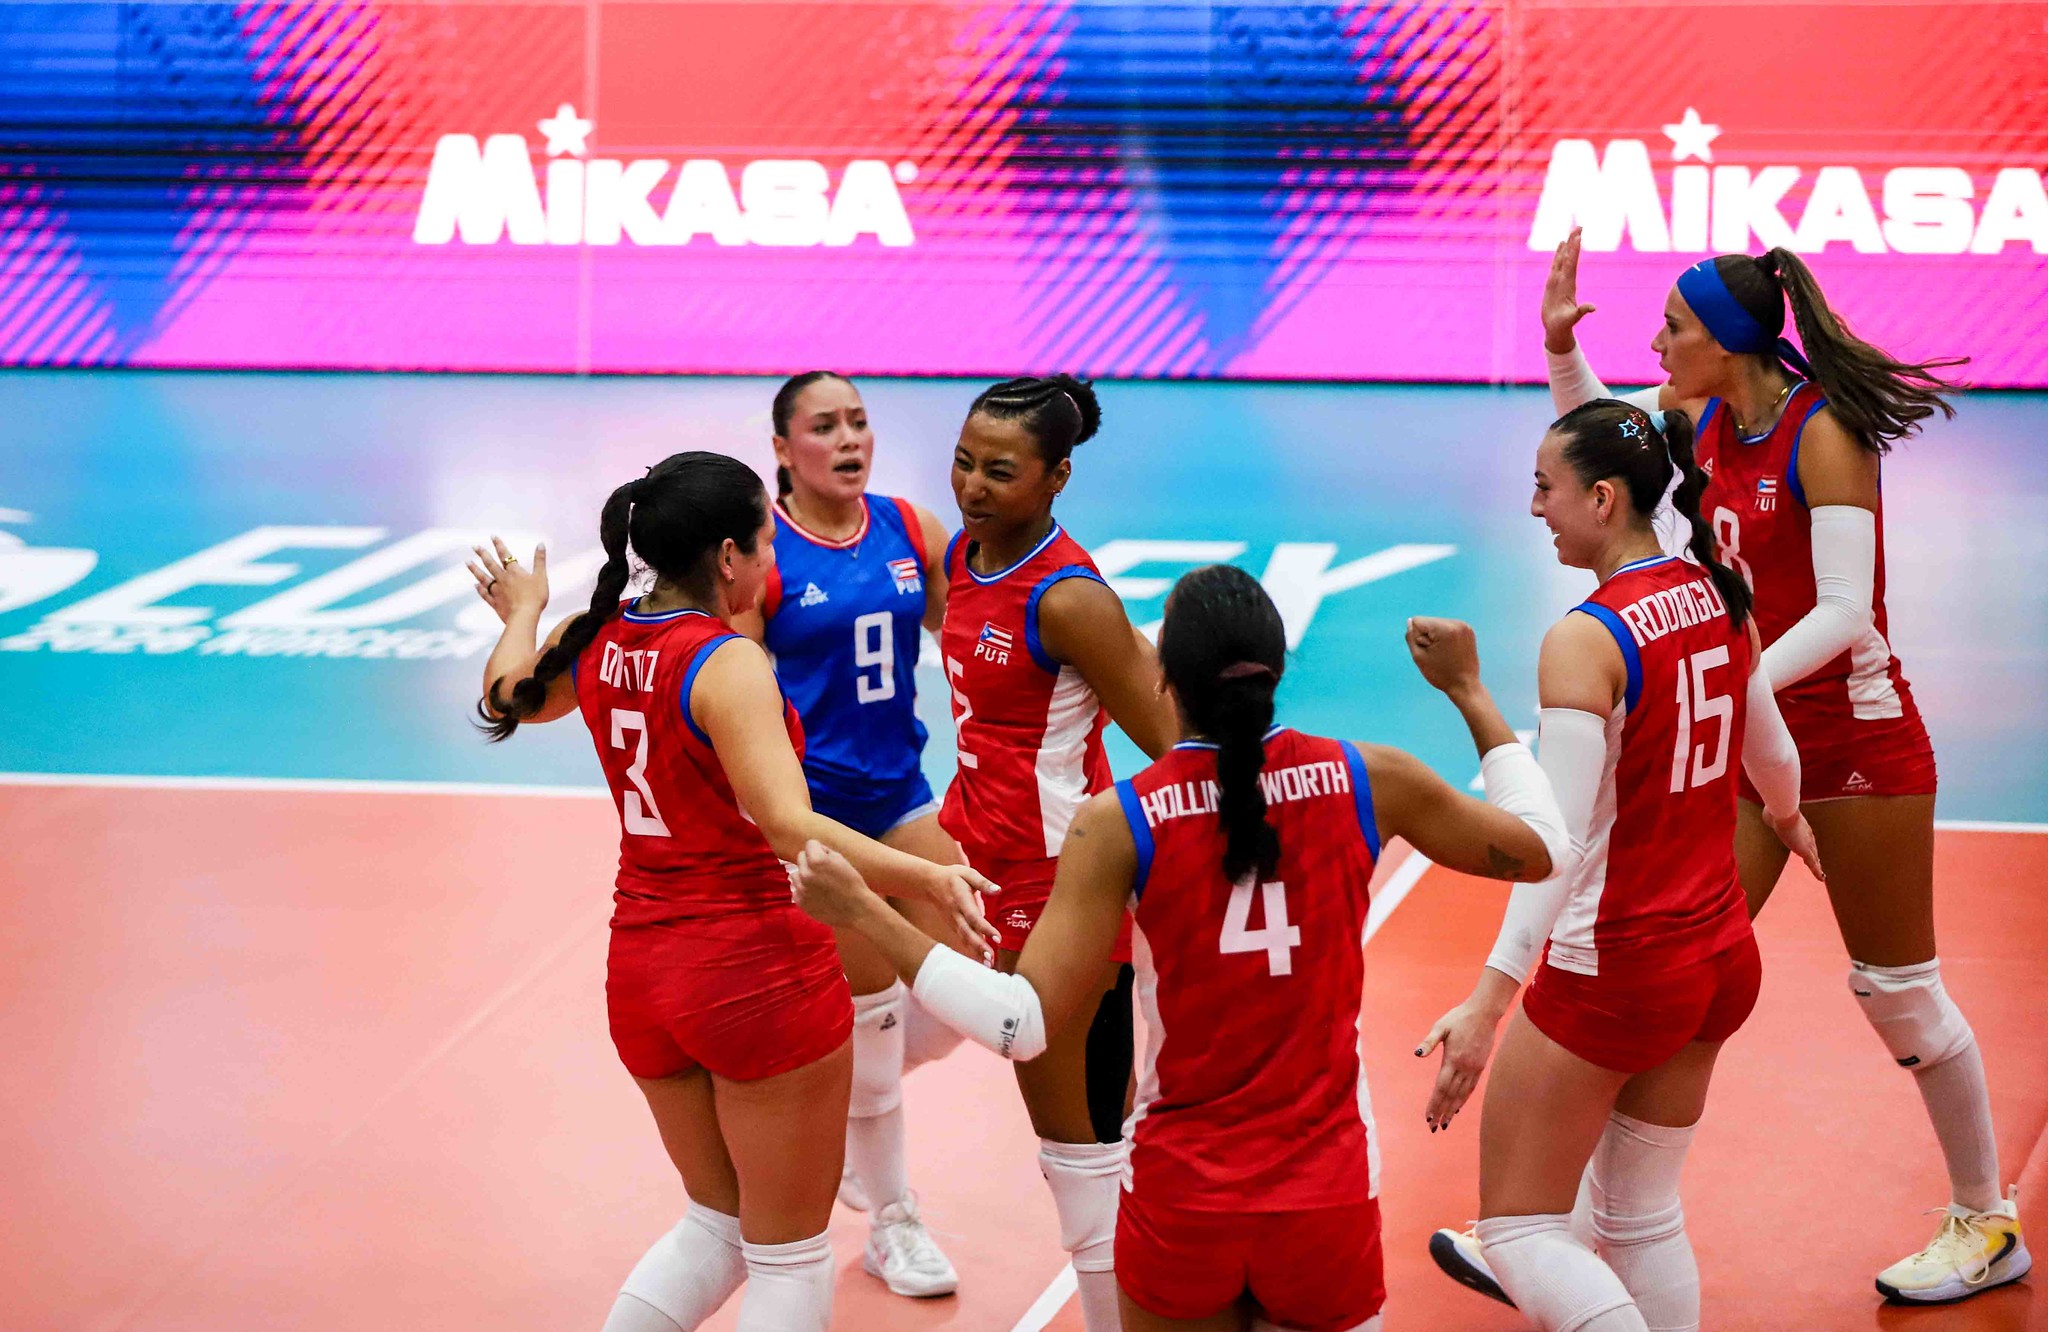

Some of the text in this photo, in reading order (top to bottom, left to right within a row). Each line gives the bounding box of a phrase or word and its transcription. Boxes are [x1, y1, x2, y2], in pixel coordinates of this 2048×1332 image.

[855, 611, 896, 705] 9
[974, 643, 1009, 666] PUR
[1618, 577, 1727, 648] RODRIGU
[1670, 645, 1734, 794] 15
[611, 708, 672, 837] 3
[1140, 760, 1350, 828] HOLLINWORTH
[1219, 868, 1302, 977] 4
